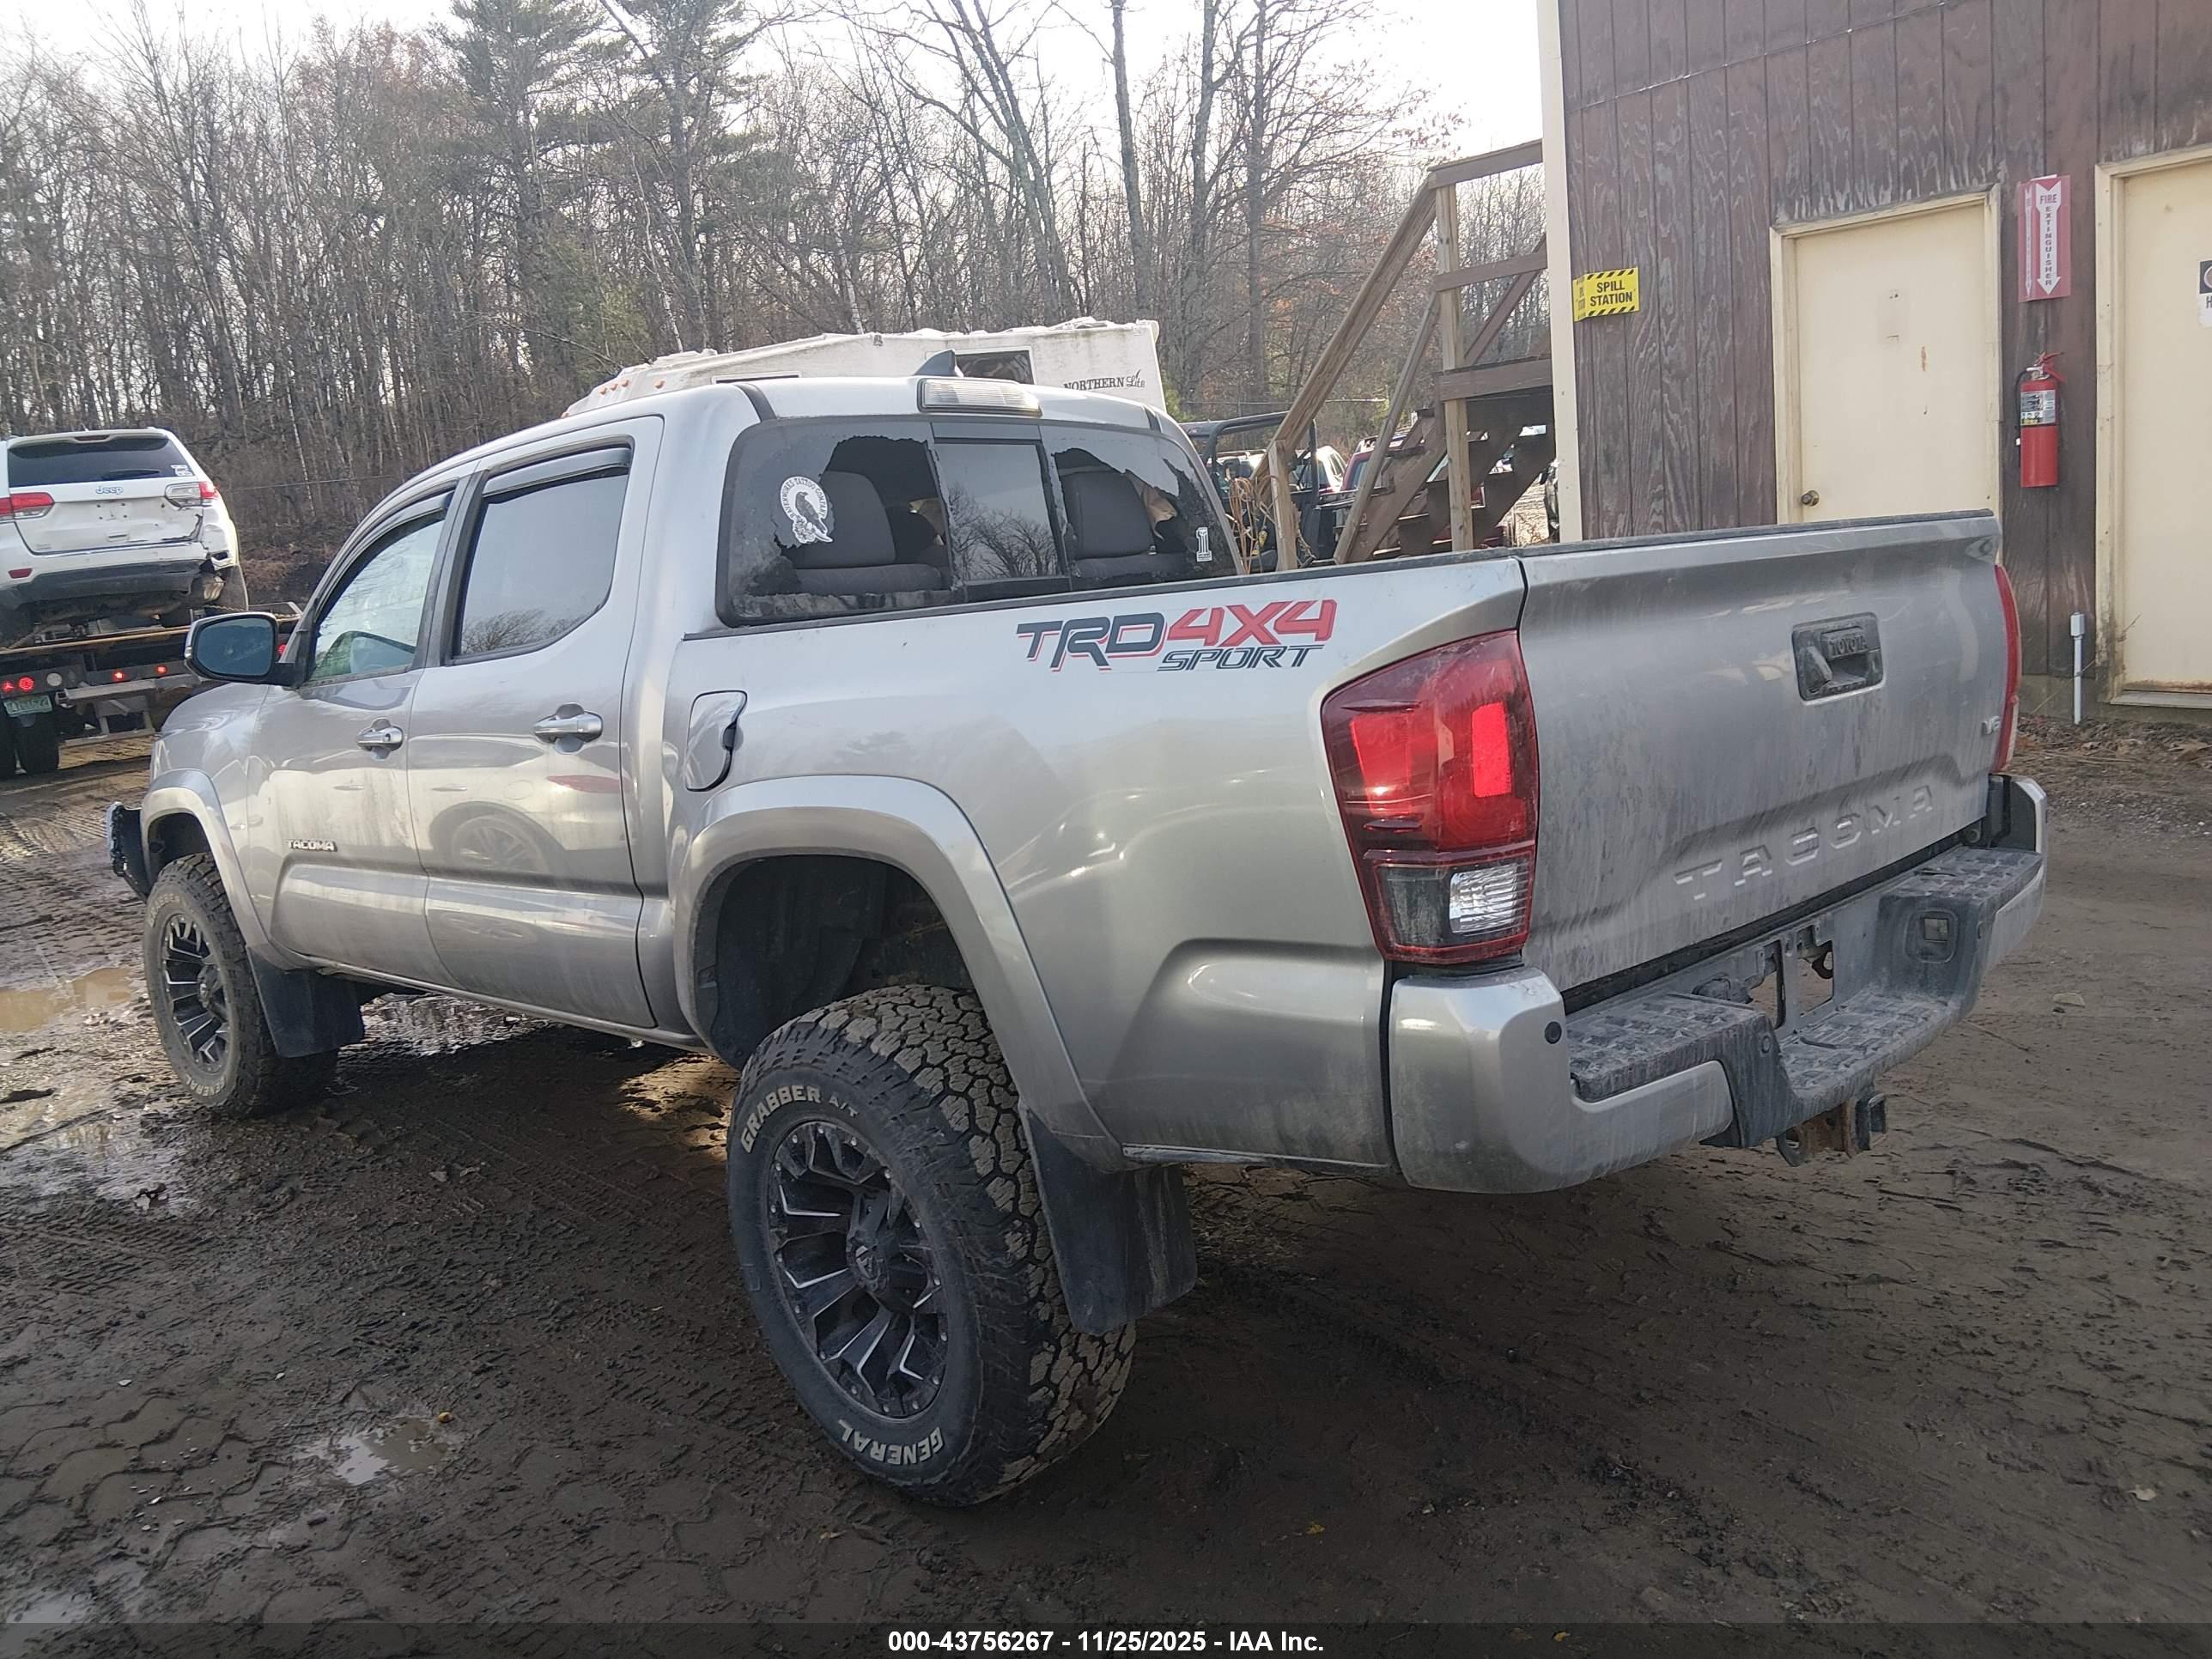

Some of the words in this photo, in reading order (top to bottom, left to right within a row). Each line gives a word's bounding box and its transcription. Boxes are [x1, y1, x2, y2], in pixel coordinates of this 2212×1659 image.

[2039, 193, 2057, 205] FIRE
[1596, 280, 1626, 294] SPILL
[1589, 291, 1633, 307] STATION
[1063, 377, 1124, 391] NORTHERN
[95, 485, 124, 495] Jeep
[1016, 611, 1166, 672] TRD
[1827, 634, 1869, 658] TOYOTA
[1156, 644, 1325, 672] SPORT
[288, 839, 336, 852] TACOMA
[740, 1085, 822, 1153] GRABBER
[829, 1091, 859, 1118] A/T
[838, 1419, 945, 1465] GENERAL
